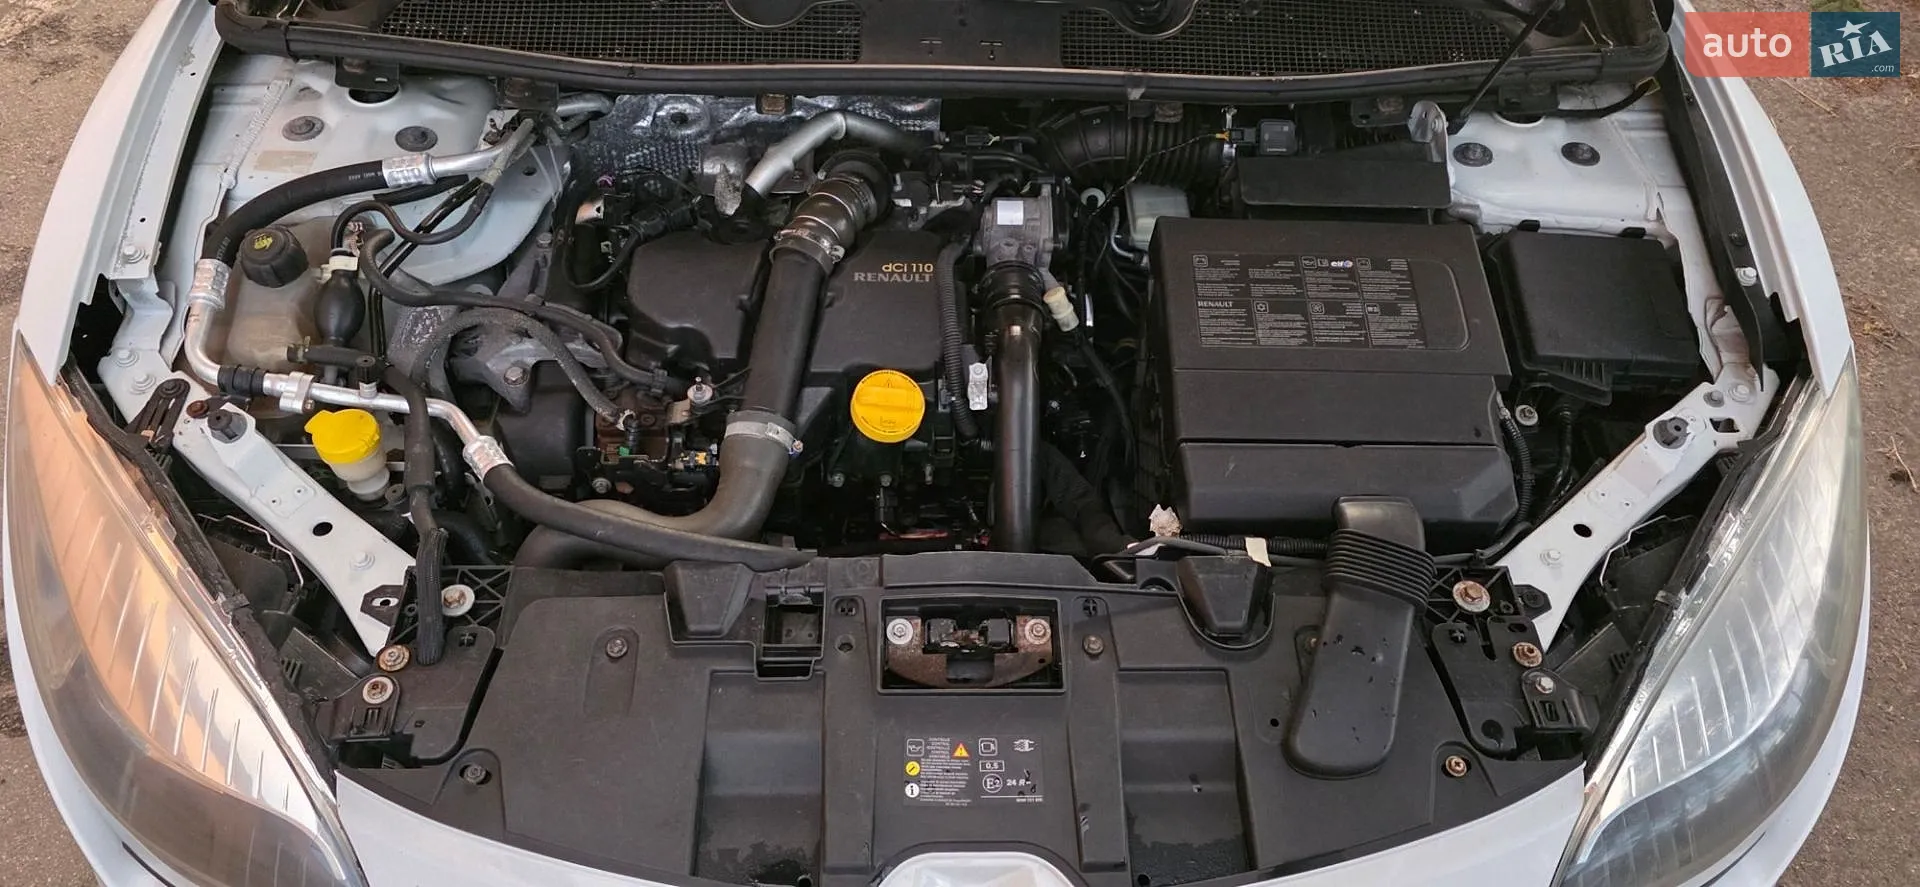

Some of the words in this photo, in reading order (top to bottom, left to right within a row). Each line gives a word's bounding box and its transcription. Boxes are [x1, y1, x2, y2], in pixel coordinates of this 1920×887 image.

[911, 263, 934, 272] 110
[854, 272, 933, 282] RENAULT
[986, 778, 1000, 789] E2
